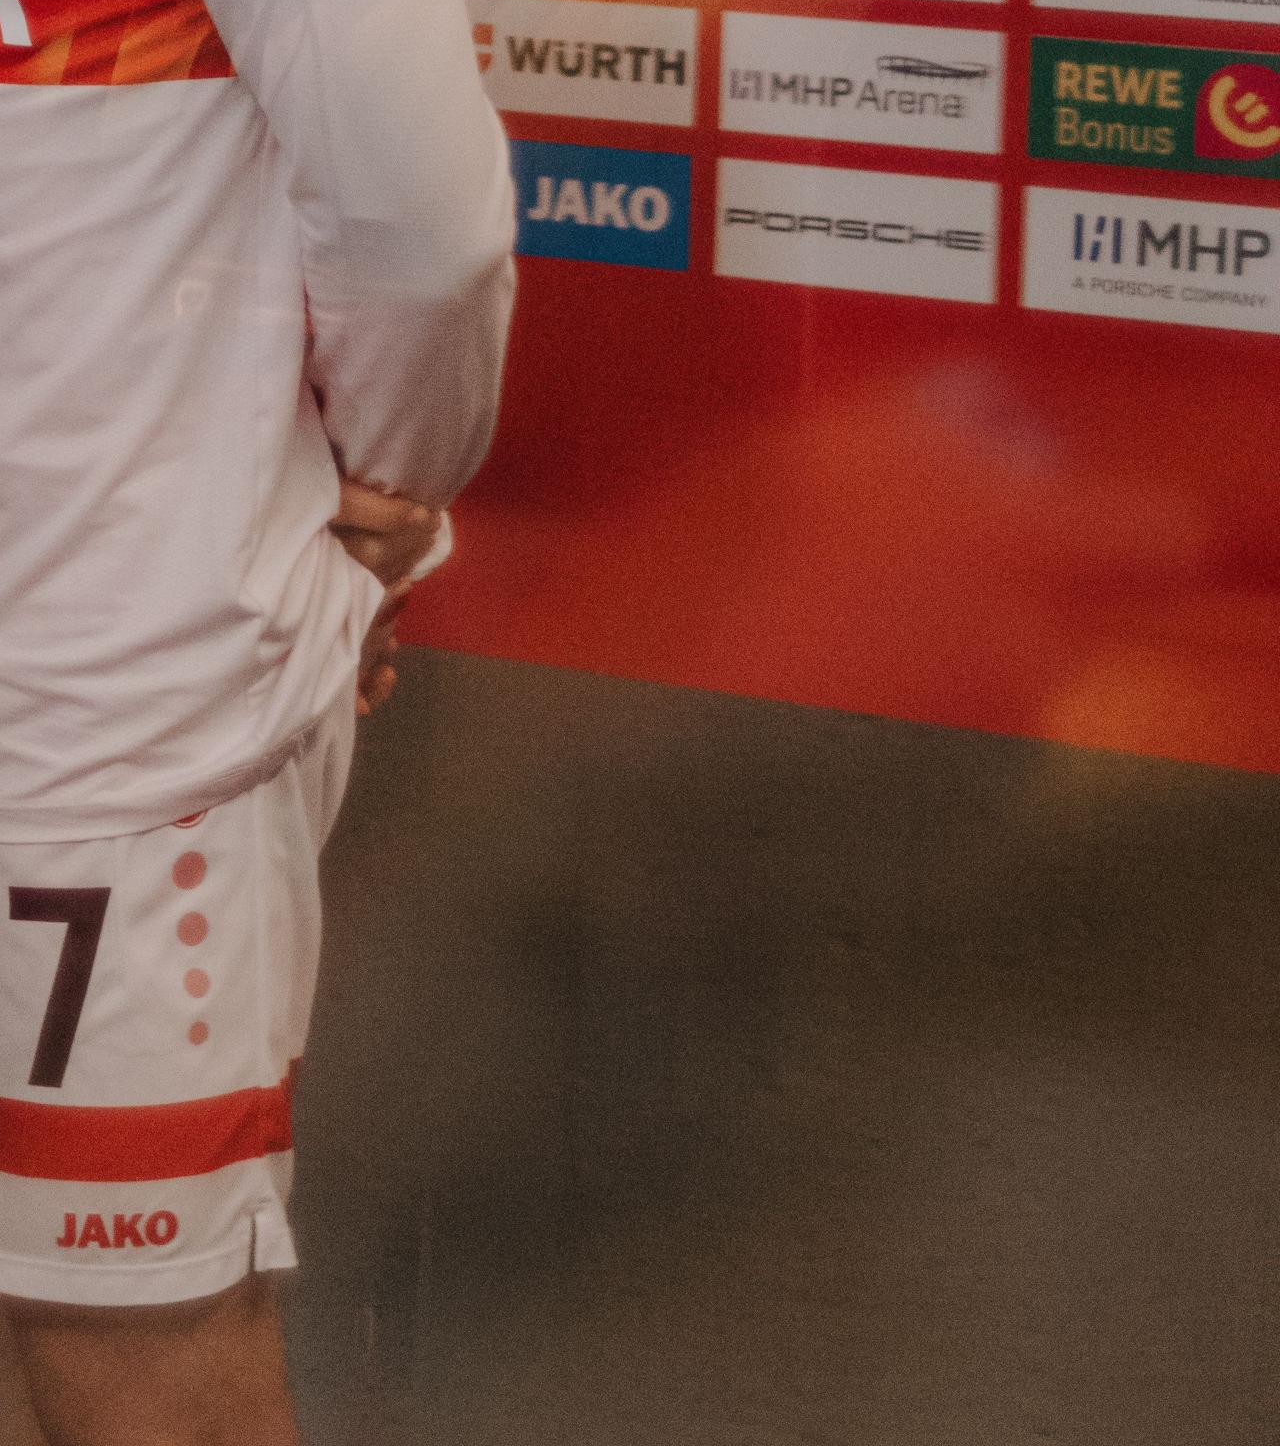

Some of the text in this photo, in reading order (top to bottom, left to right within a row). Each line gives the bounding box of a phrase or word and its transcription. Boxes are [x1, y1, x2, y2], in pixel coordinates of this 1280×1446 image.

[1056, 62, 1184, 109] REWE
[1056, 108, 1175, 155] Bonus
[529, 176, 671, 232] JAKO
[726, 209, 986, 252] PORSCHE
[1139, 220, 1270, 276] MHP
[8, 886, 111, 1088] 7
[56, 1210, 178, 1249] JAKO
